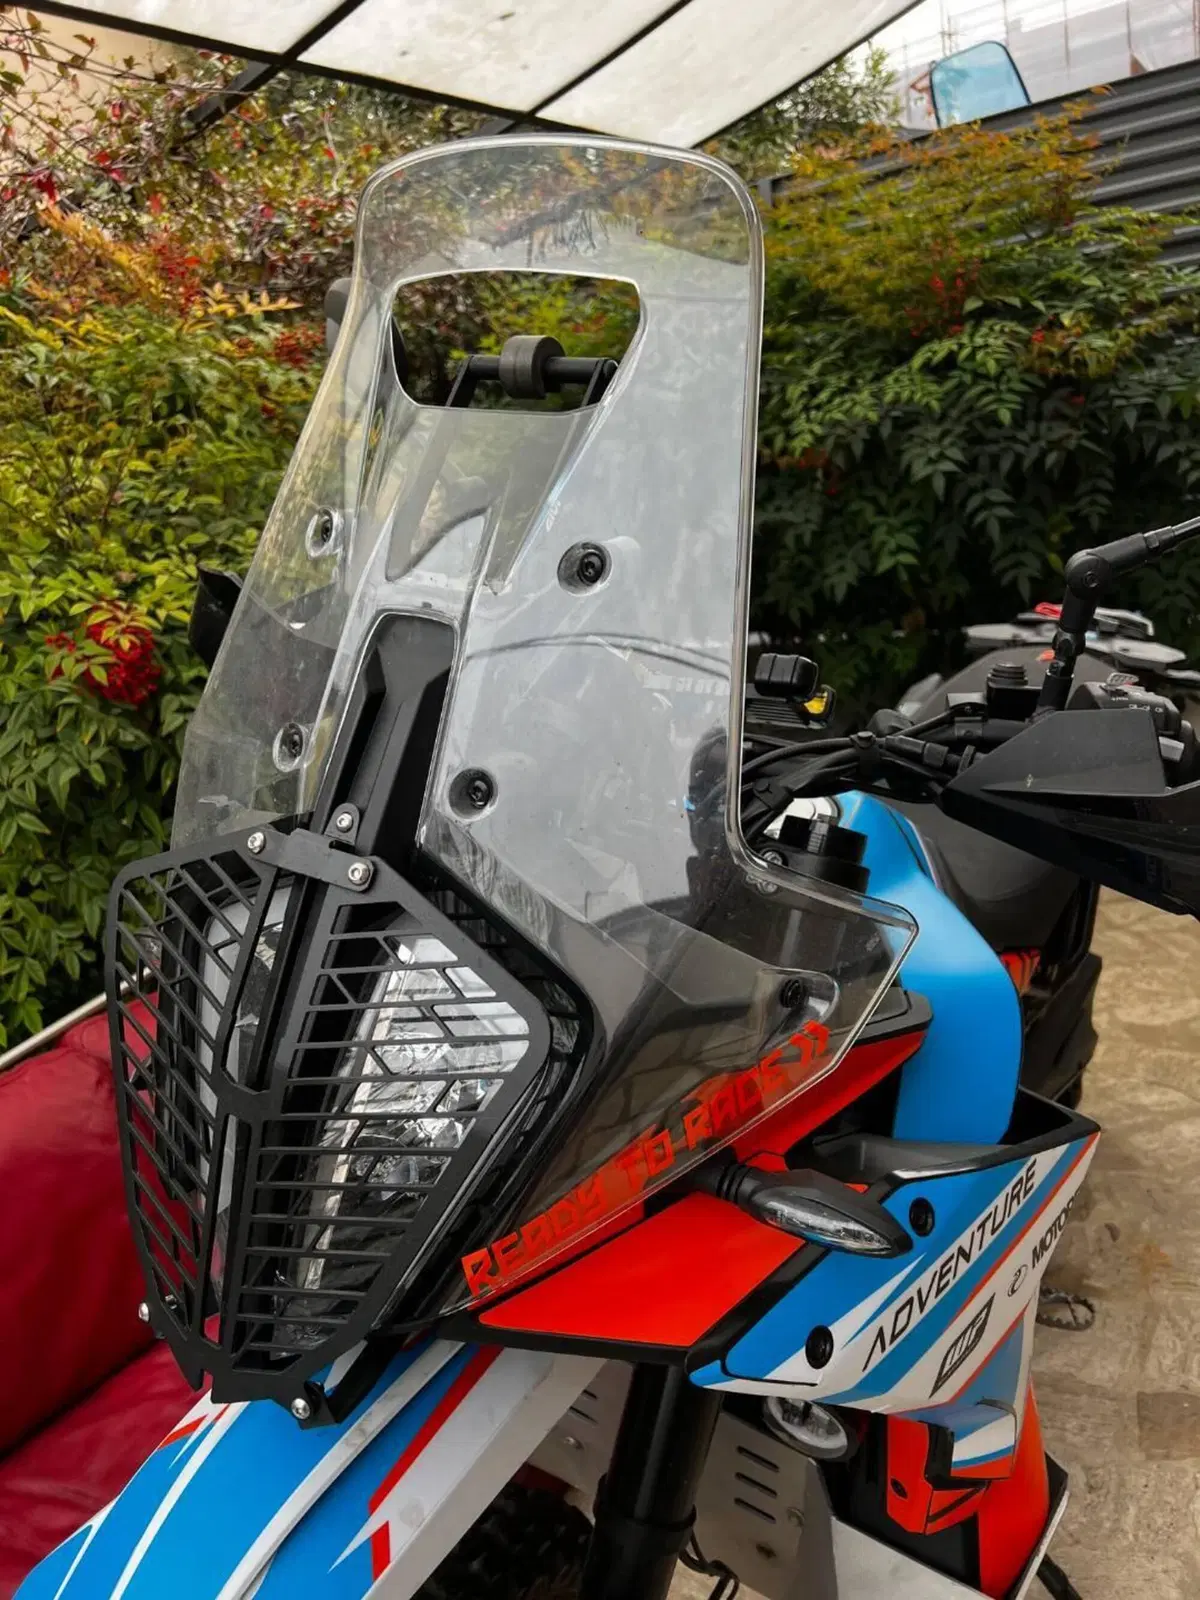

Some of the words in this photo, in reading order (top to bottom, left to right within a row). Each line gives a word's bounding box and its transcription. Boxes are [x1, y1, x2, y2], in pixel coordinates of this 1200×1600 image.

[461, 1172, 607, 1297] READY
[614, 1126, 675, 1190] TO
[683, 1048, 785, 1151] RACE
[862, 1158, 1036, 1372] ADVENTURE
